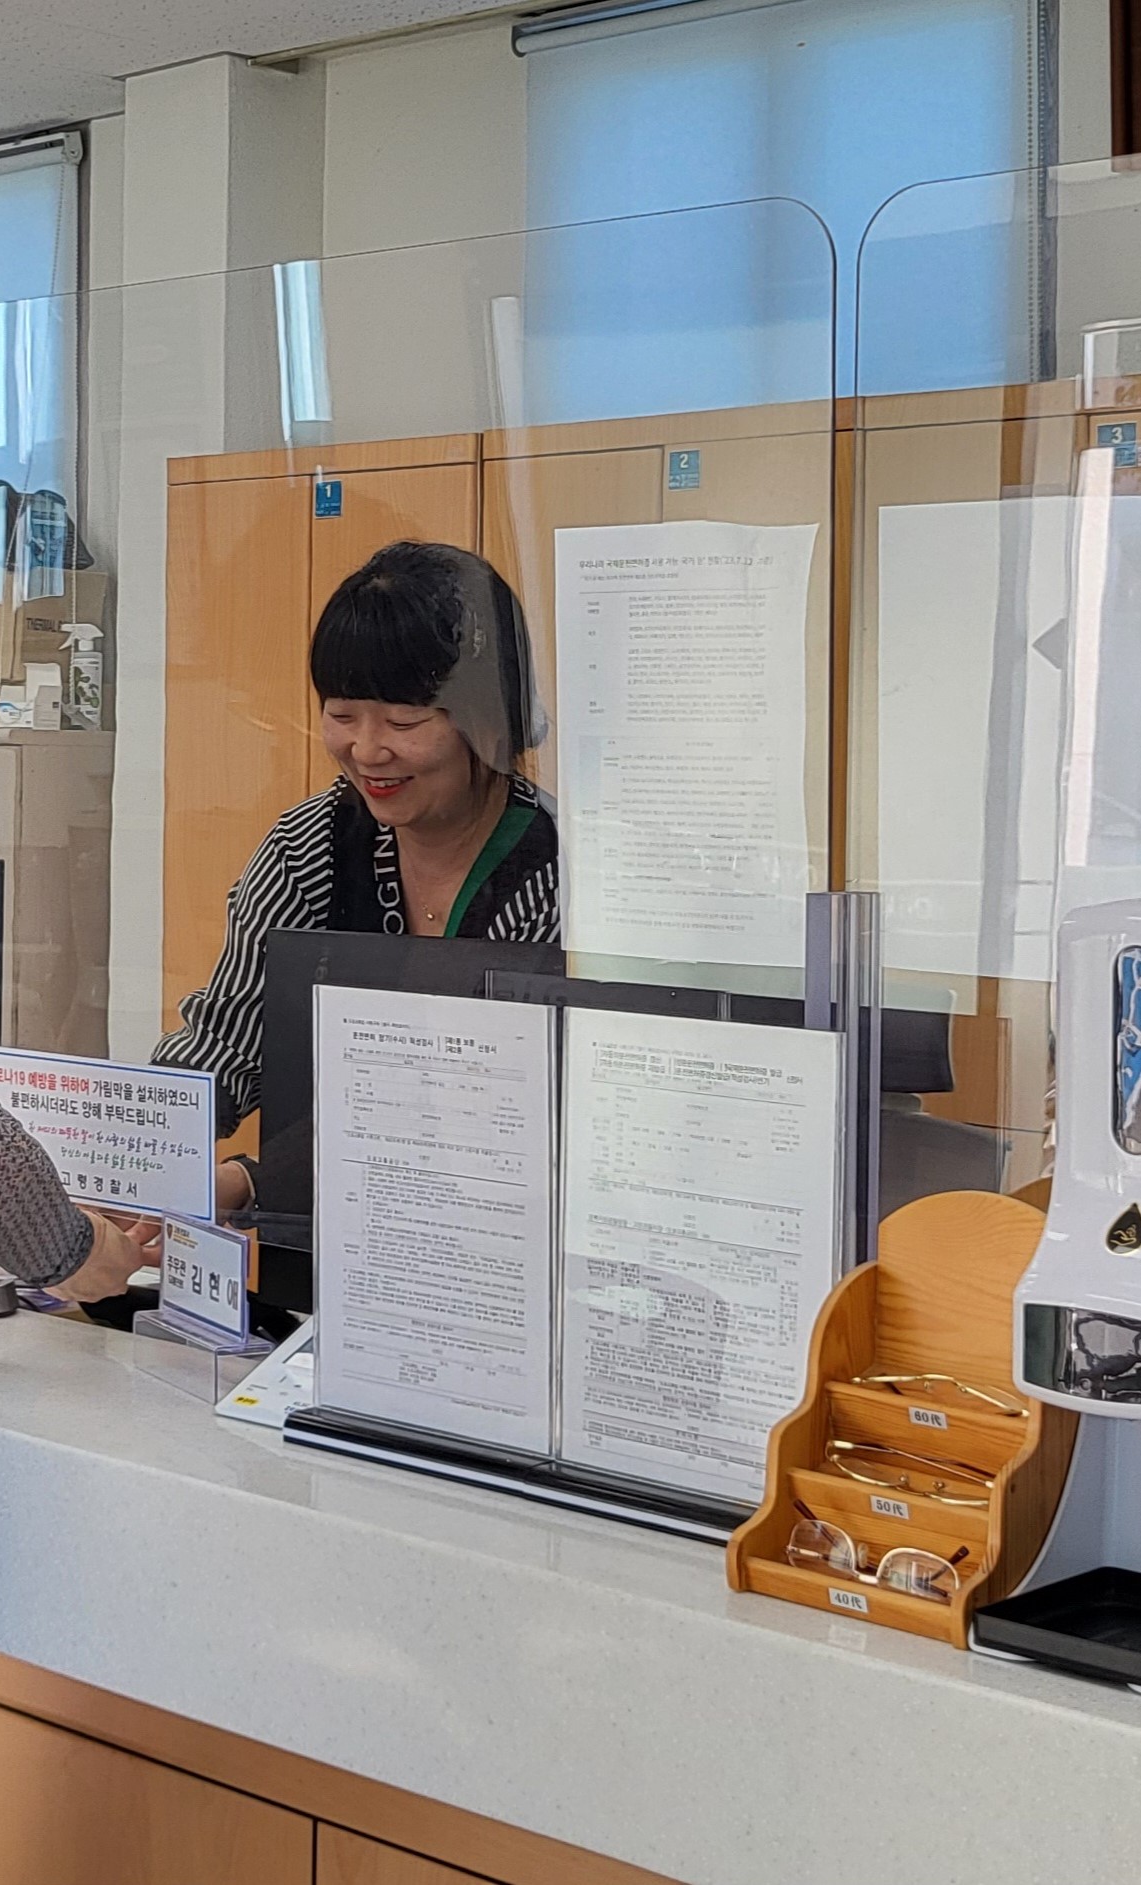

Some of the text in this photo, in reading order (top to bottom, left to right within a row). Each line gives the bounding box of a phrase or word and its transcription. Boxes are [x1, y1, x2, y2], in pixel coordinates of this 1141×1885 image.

[1111, 427, 1123, 444] 3
[679, 453, 689, 469] 2
[325, 484, 332, 498] 1
[28, 1071, 57, 1092] 예방을
[60, 1074, 90, 1095] 위하여
[92, 1079, 133, 1101] 가림막을
[136, 1085, 200, 1110] 설치하였으니
[10, 1091, 170, 1130] 불편하시더라도 양해 부탁드립니다.
